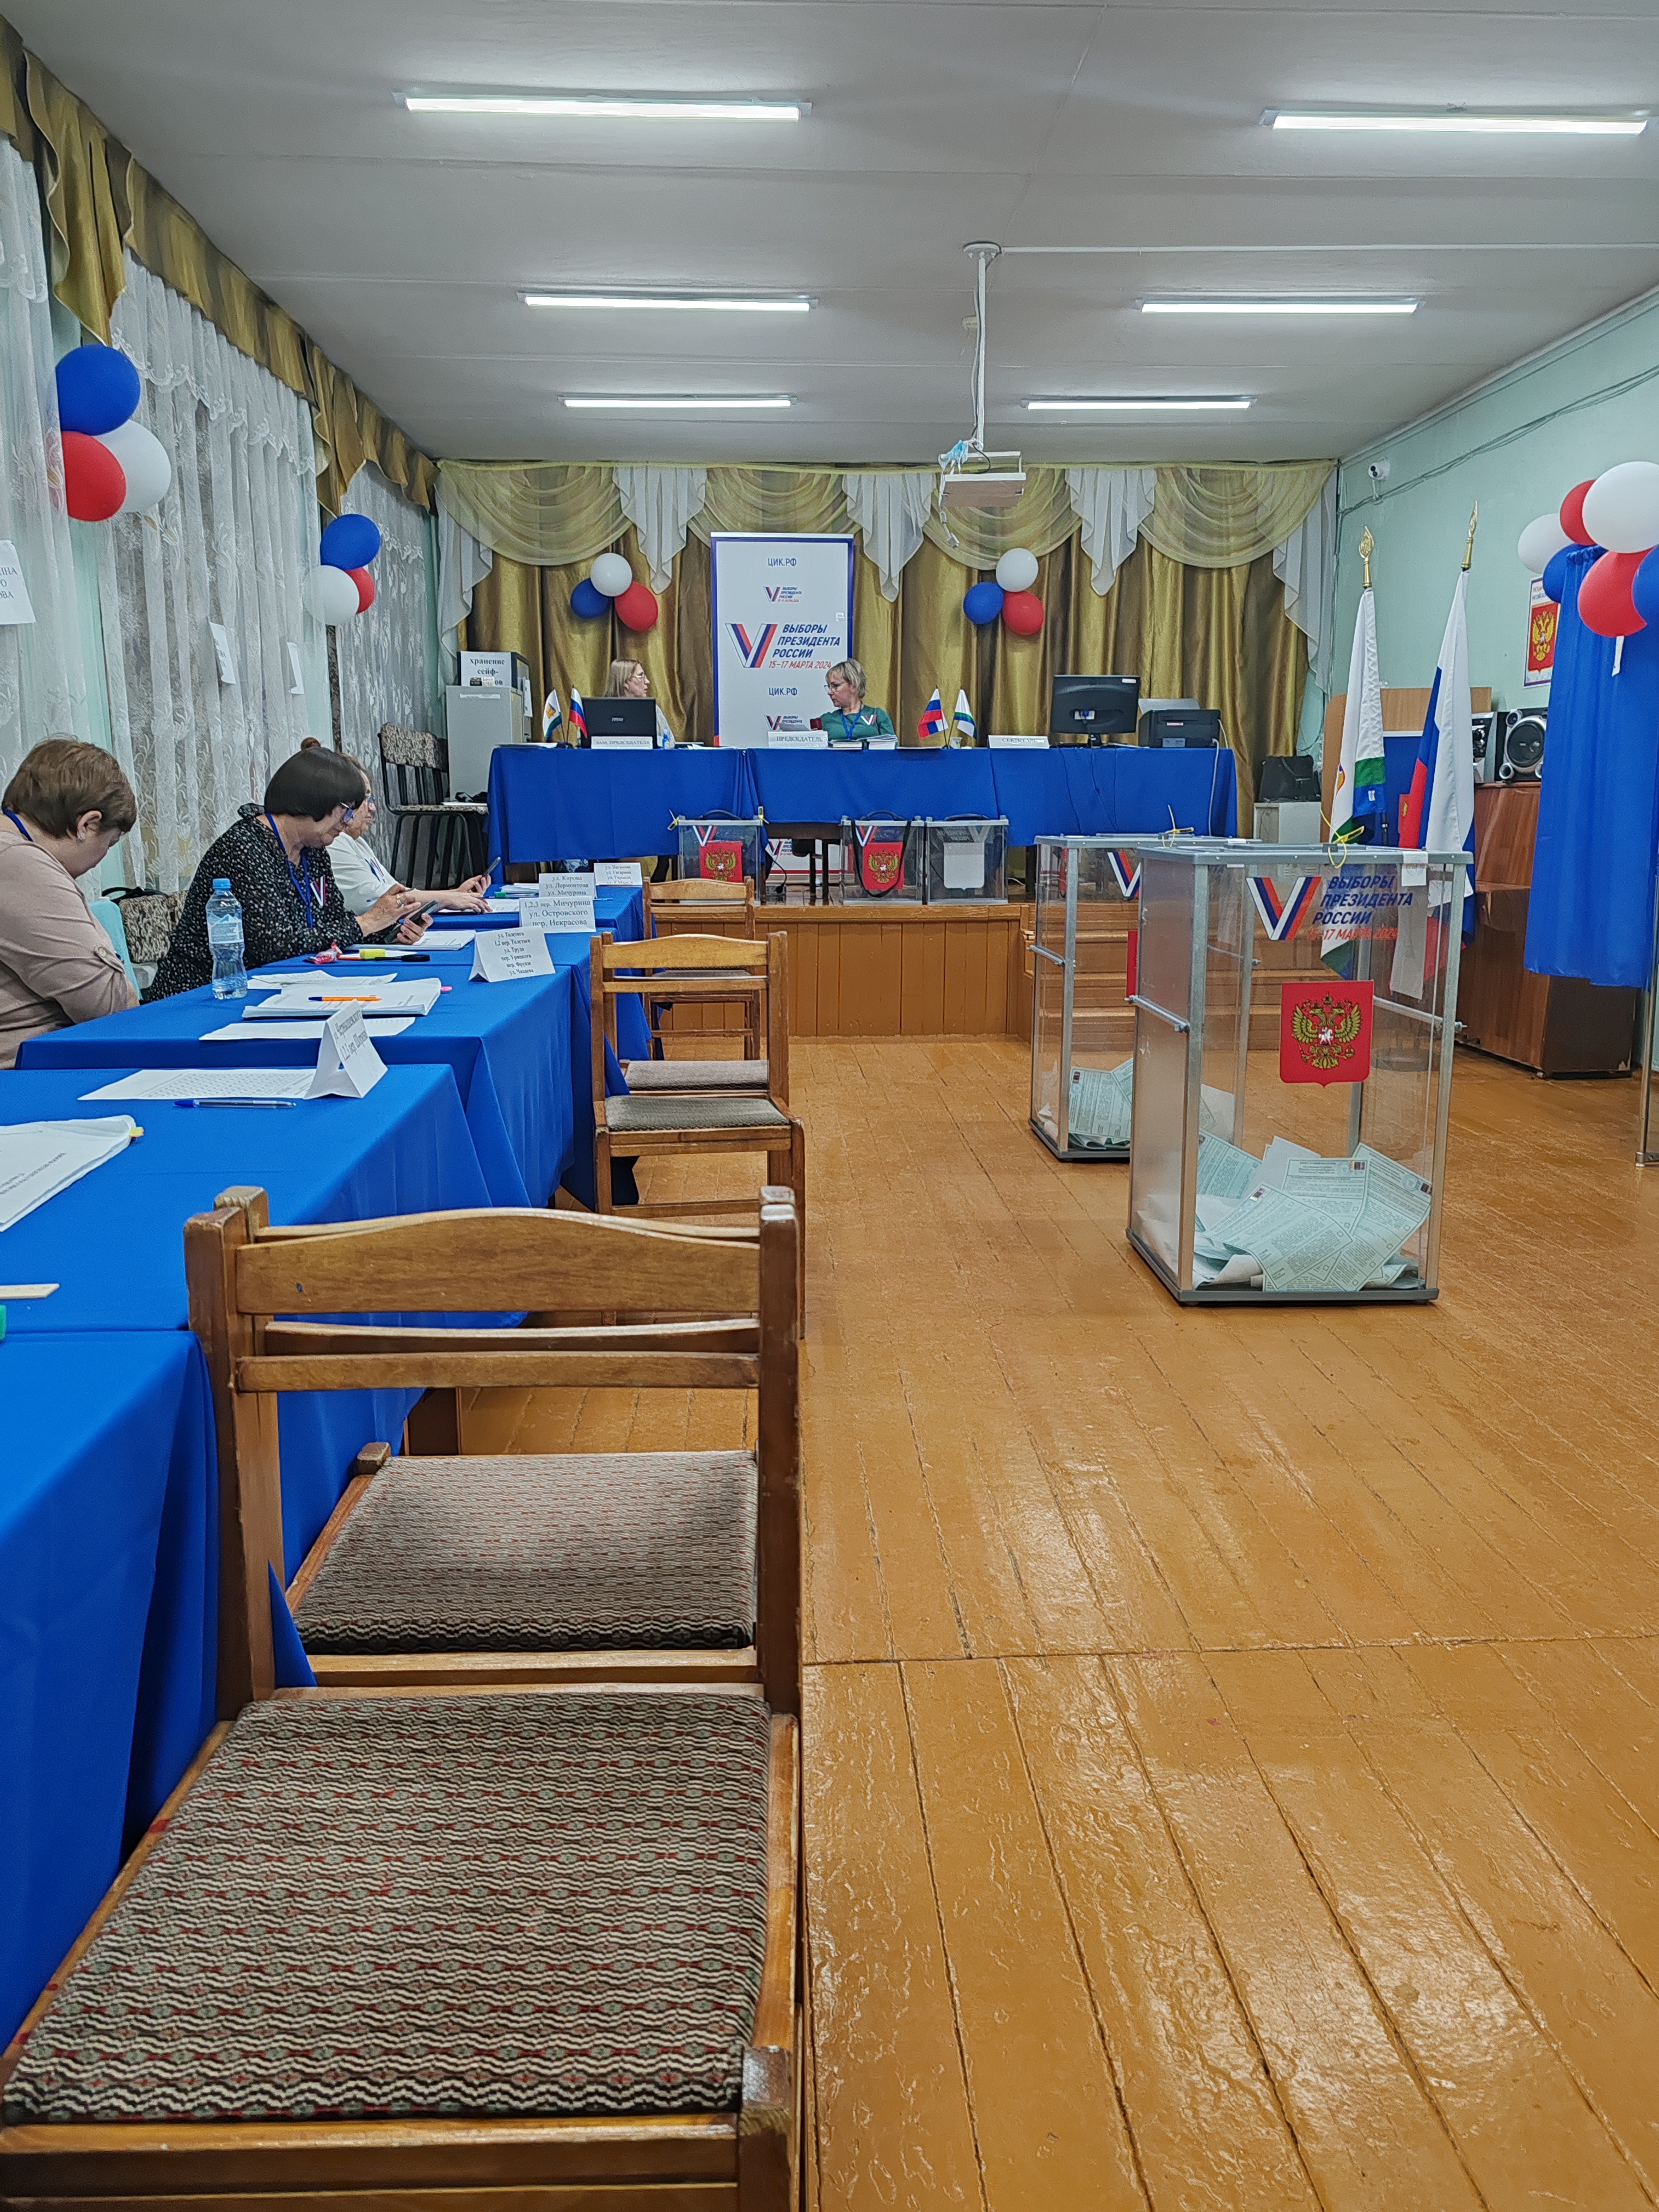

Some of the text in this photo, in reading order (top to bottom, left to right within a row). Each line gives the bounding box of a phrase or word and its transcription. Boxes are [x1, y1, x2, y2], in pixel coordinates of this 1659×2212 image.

[768, 557, 797, 567] ЦИК.РФ
[782, 624, 828, 634] ВЫБОРЫ
[777, 636, 841, 647] ПРЕЗИДЕНТА
[772, 648, 814, 658] РОССИИ
[789, 661, 814, 669] МАРТА
[814, 661, 832, 669] 2024
[477, 668, 499, 676] сейф-
[769, 687, 798, 697] ЦИК.РФ
[1328, 876, 1394, 889] ВЫБОРЫ
[553, 900, 591, 908] Мичурина
[1320, 893, 1413, 908] ПРЕЗИДЕНТА
[542, 910, 588, 918] Островского
[1312, 912, 1373, 925] РОССИИ
